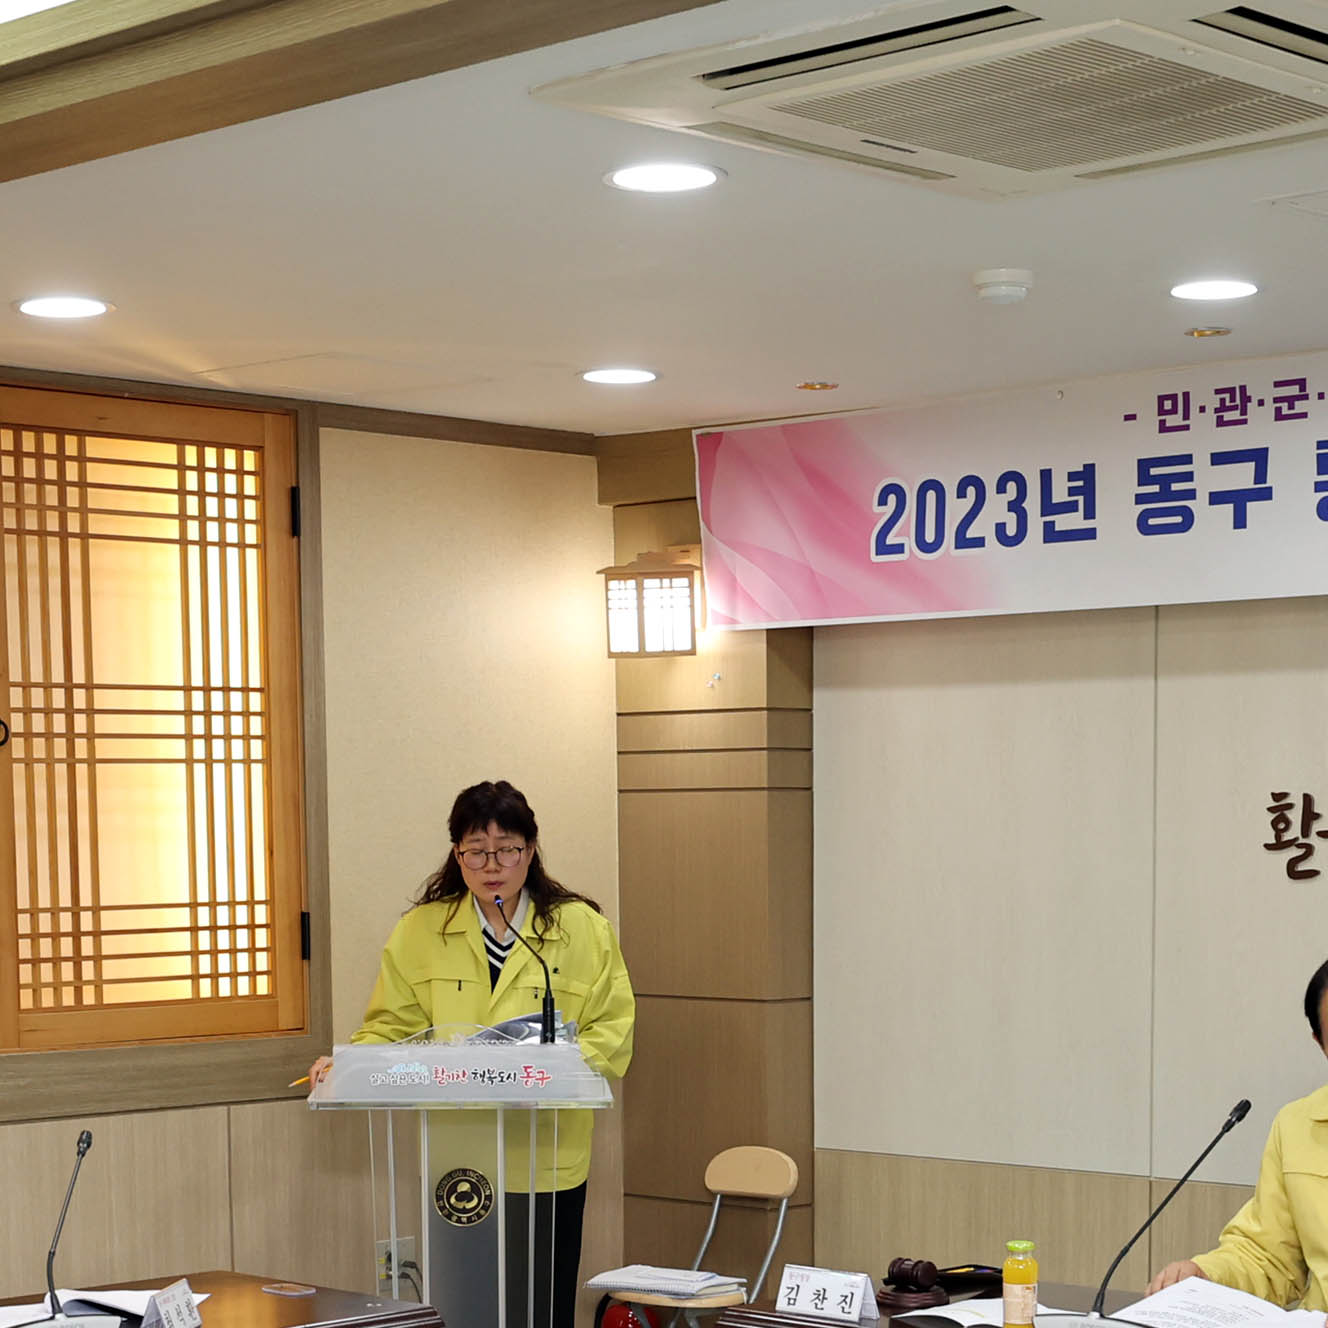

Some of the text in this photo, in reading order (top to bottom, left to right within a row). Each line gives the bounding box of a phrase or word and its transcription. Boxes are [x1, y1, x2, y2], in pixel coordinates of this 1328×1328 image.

[874, 462, 1097, 557] 2023년
[1134, 447, 1273, 536] 동구
[433, 1066, 468, 1086] 활기찬
[471, 1067, 518, 1086] 행복도시
[520, 1064, 551, 1088] 동구
[784, 1283, 855, 1315] 김찬진
